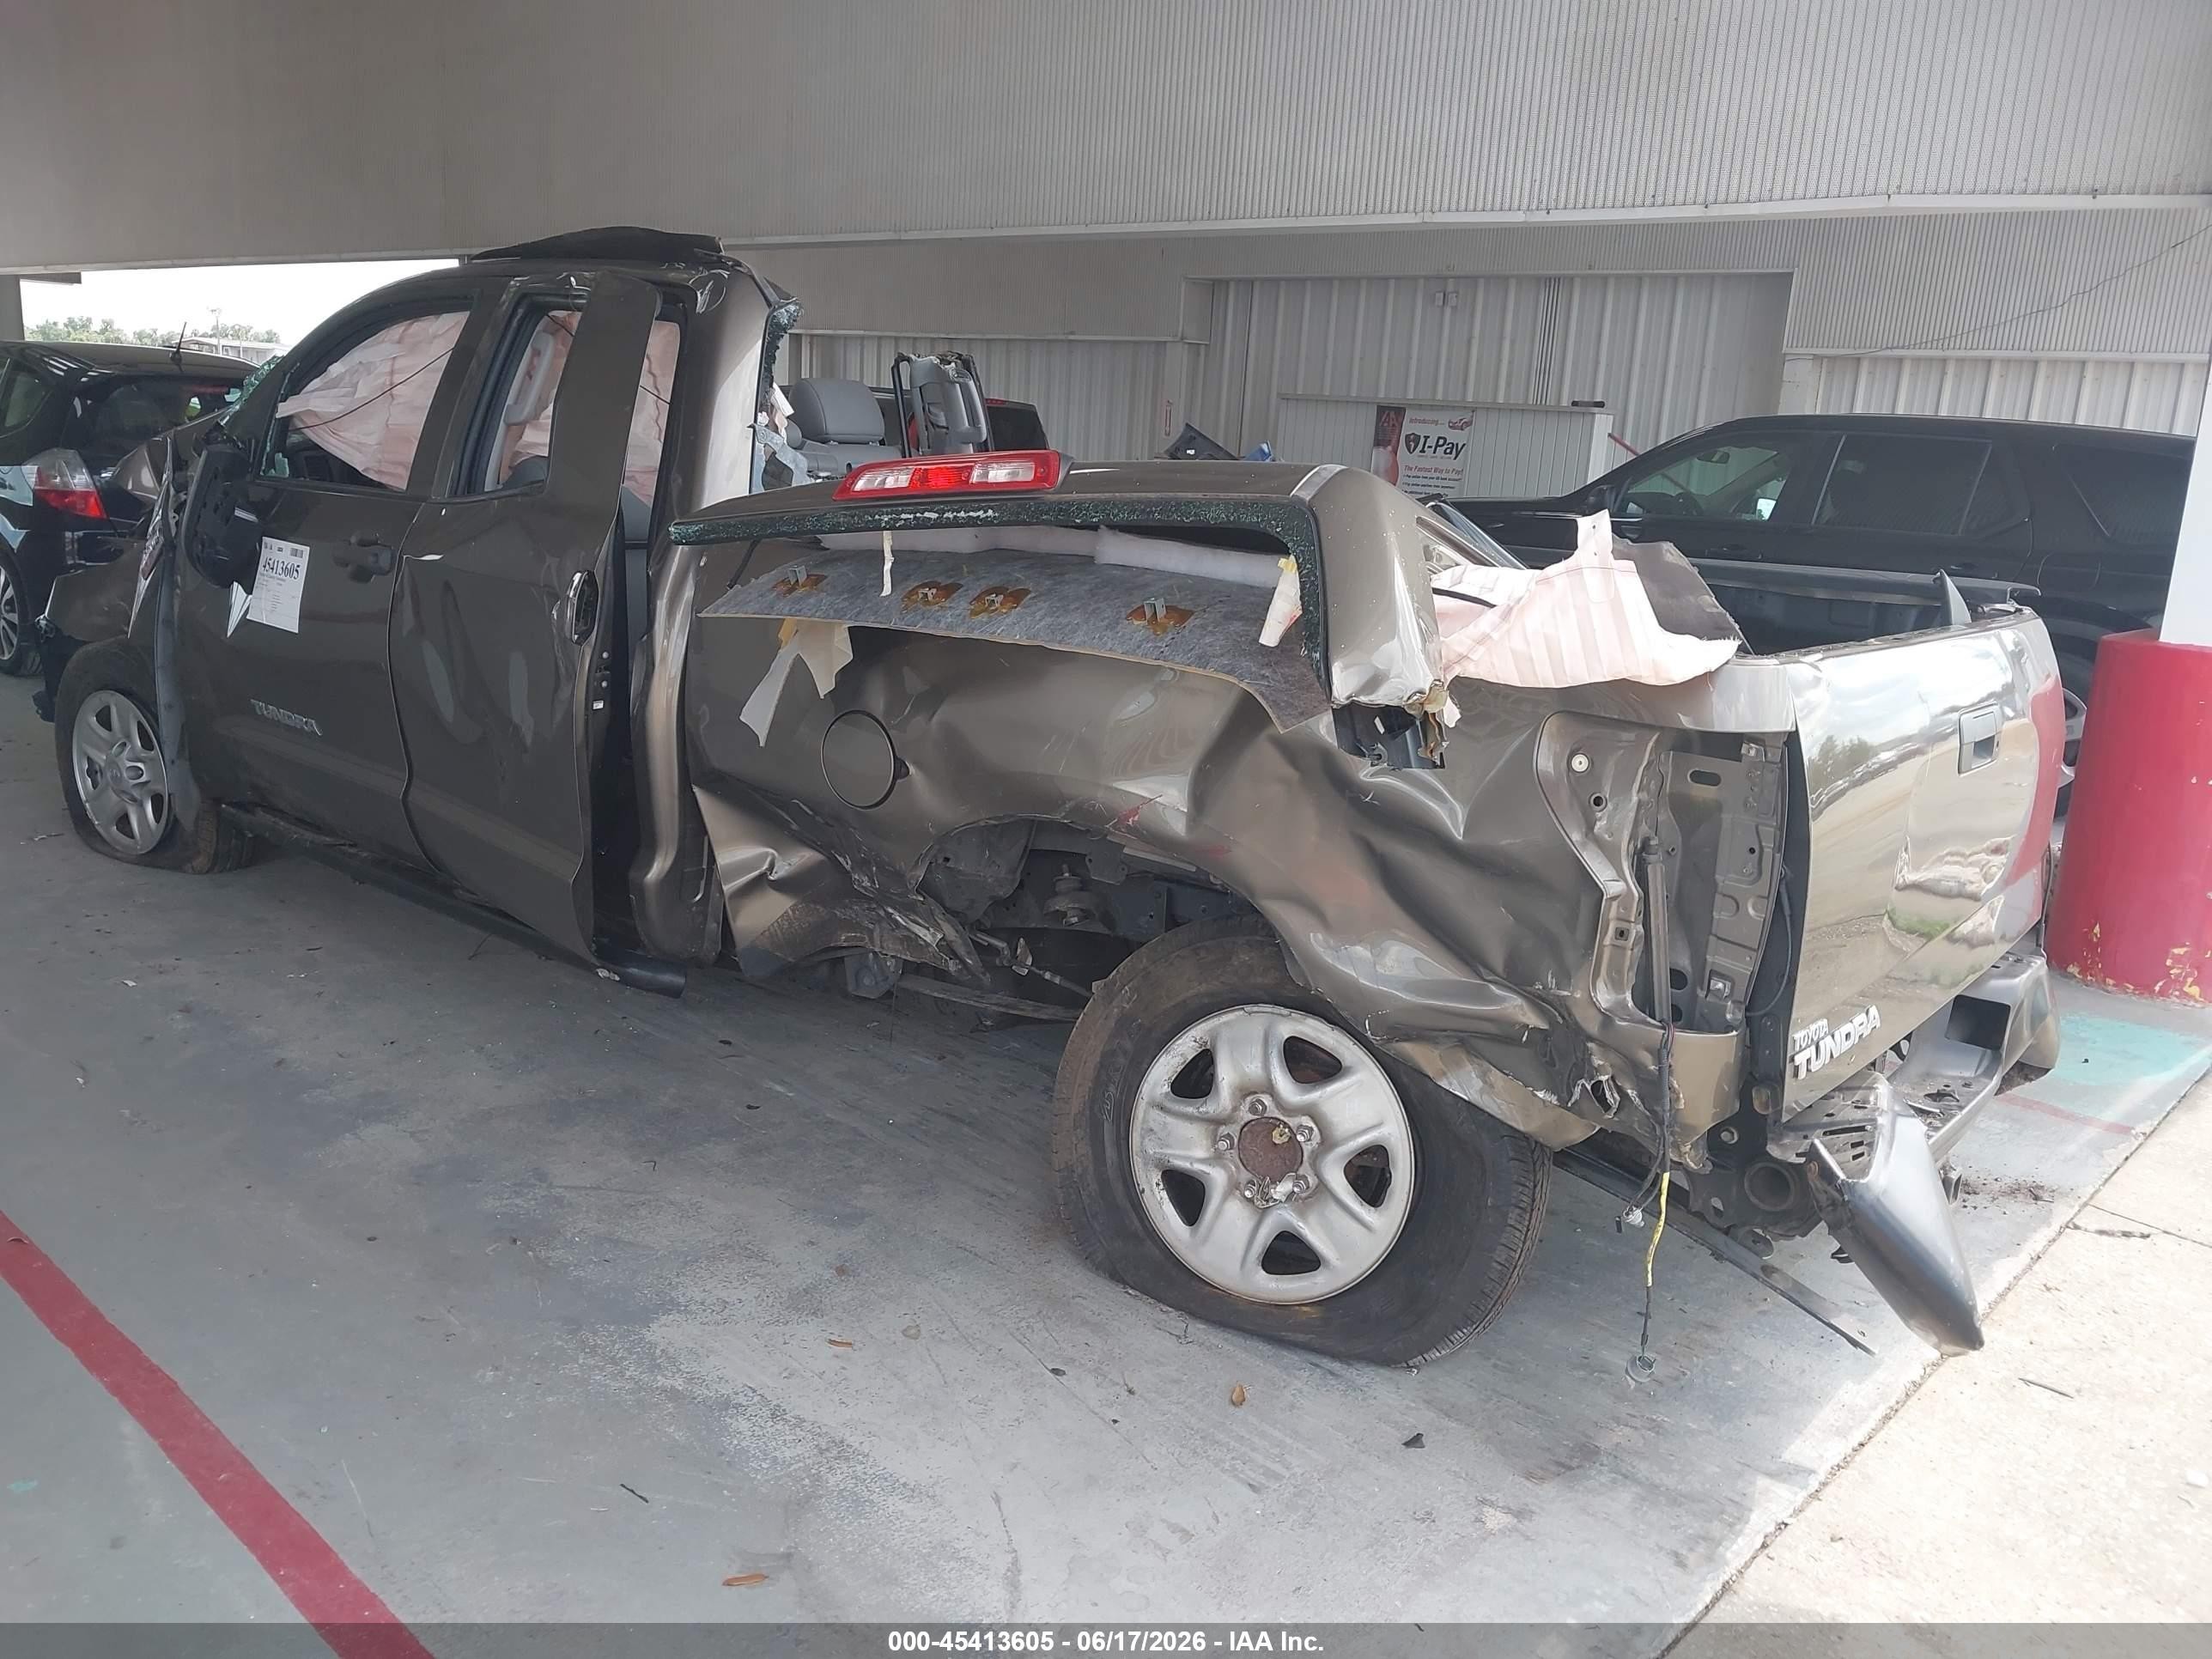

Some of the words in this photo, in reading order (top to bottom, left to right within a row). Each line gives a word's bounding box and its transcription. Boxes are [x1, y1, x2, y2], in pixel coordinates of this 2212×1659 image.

[1419, 434, 1467, 460] I-Pay
[262, 556, 301, 580] 45413605
[251, 699, 324, 736] TUNDRA
[1792, 1018, 1829, 1051] TOYOTA
[1792, 1005, 1881, 1080] TUNDRA
